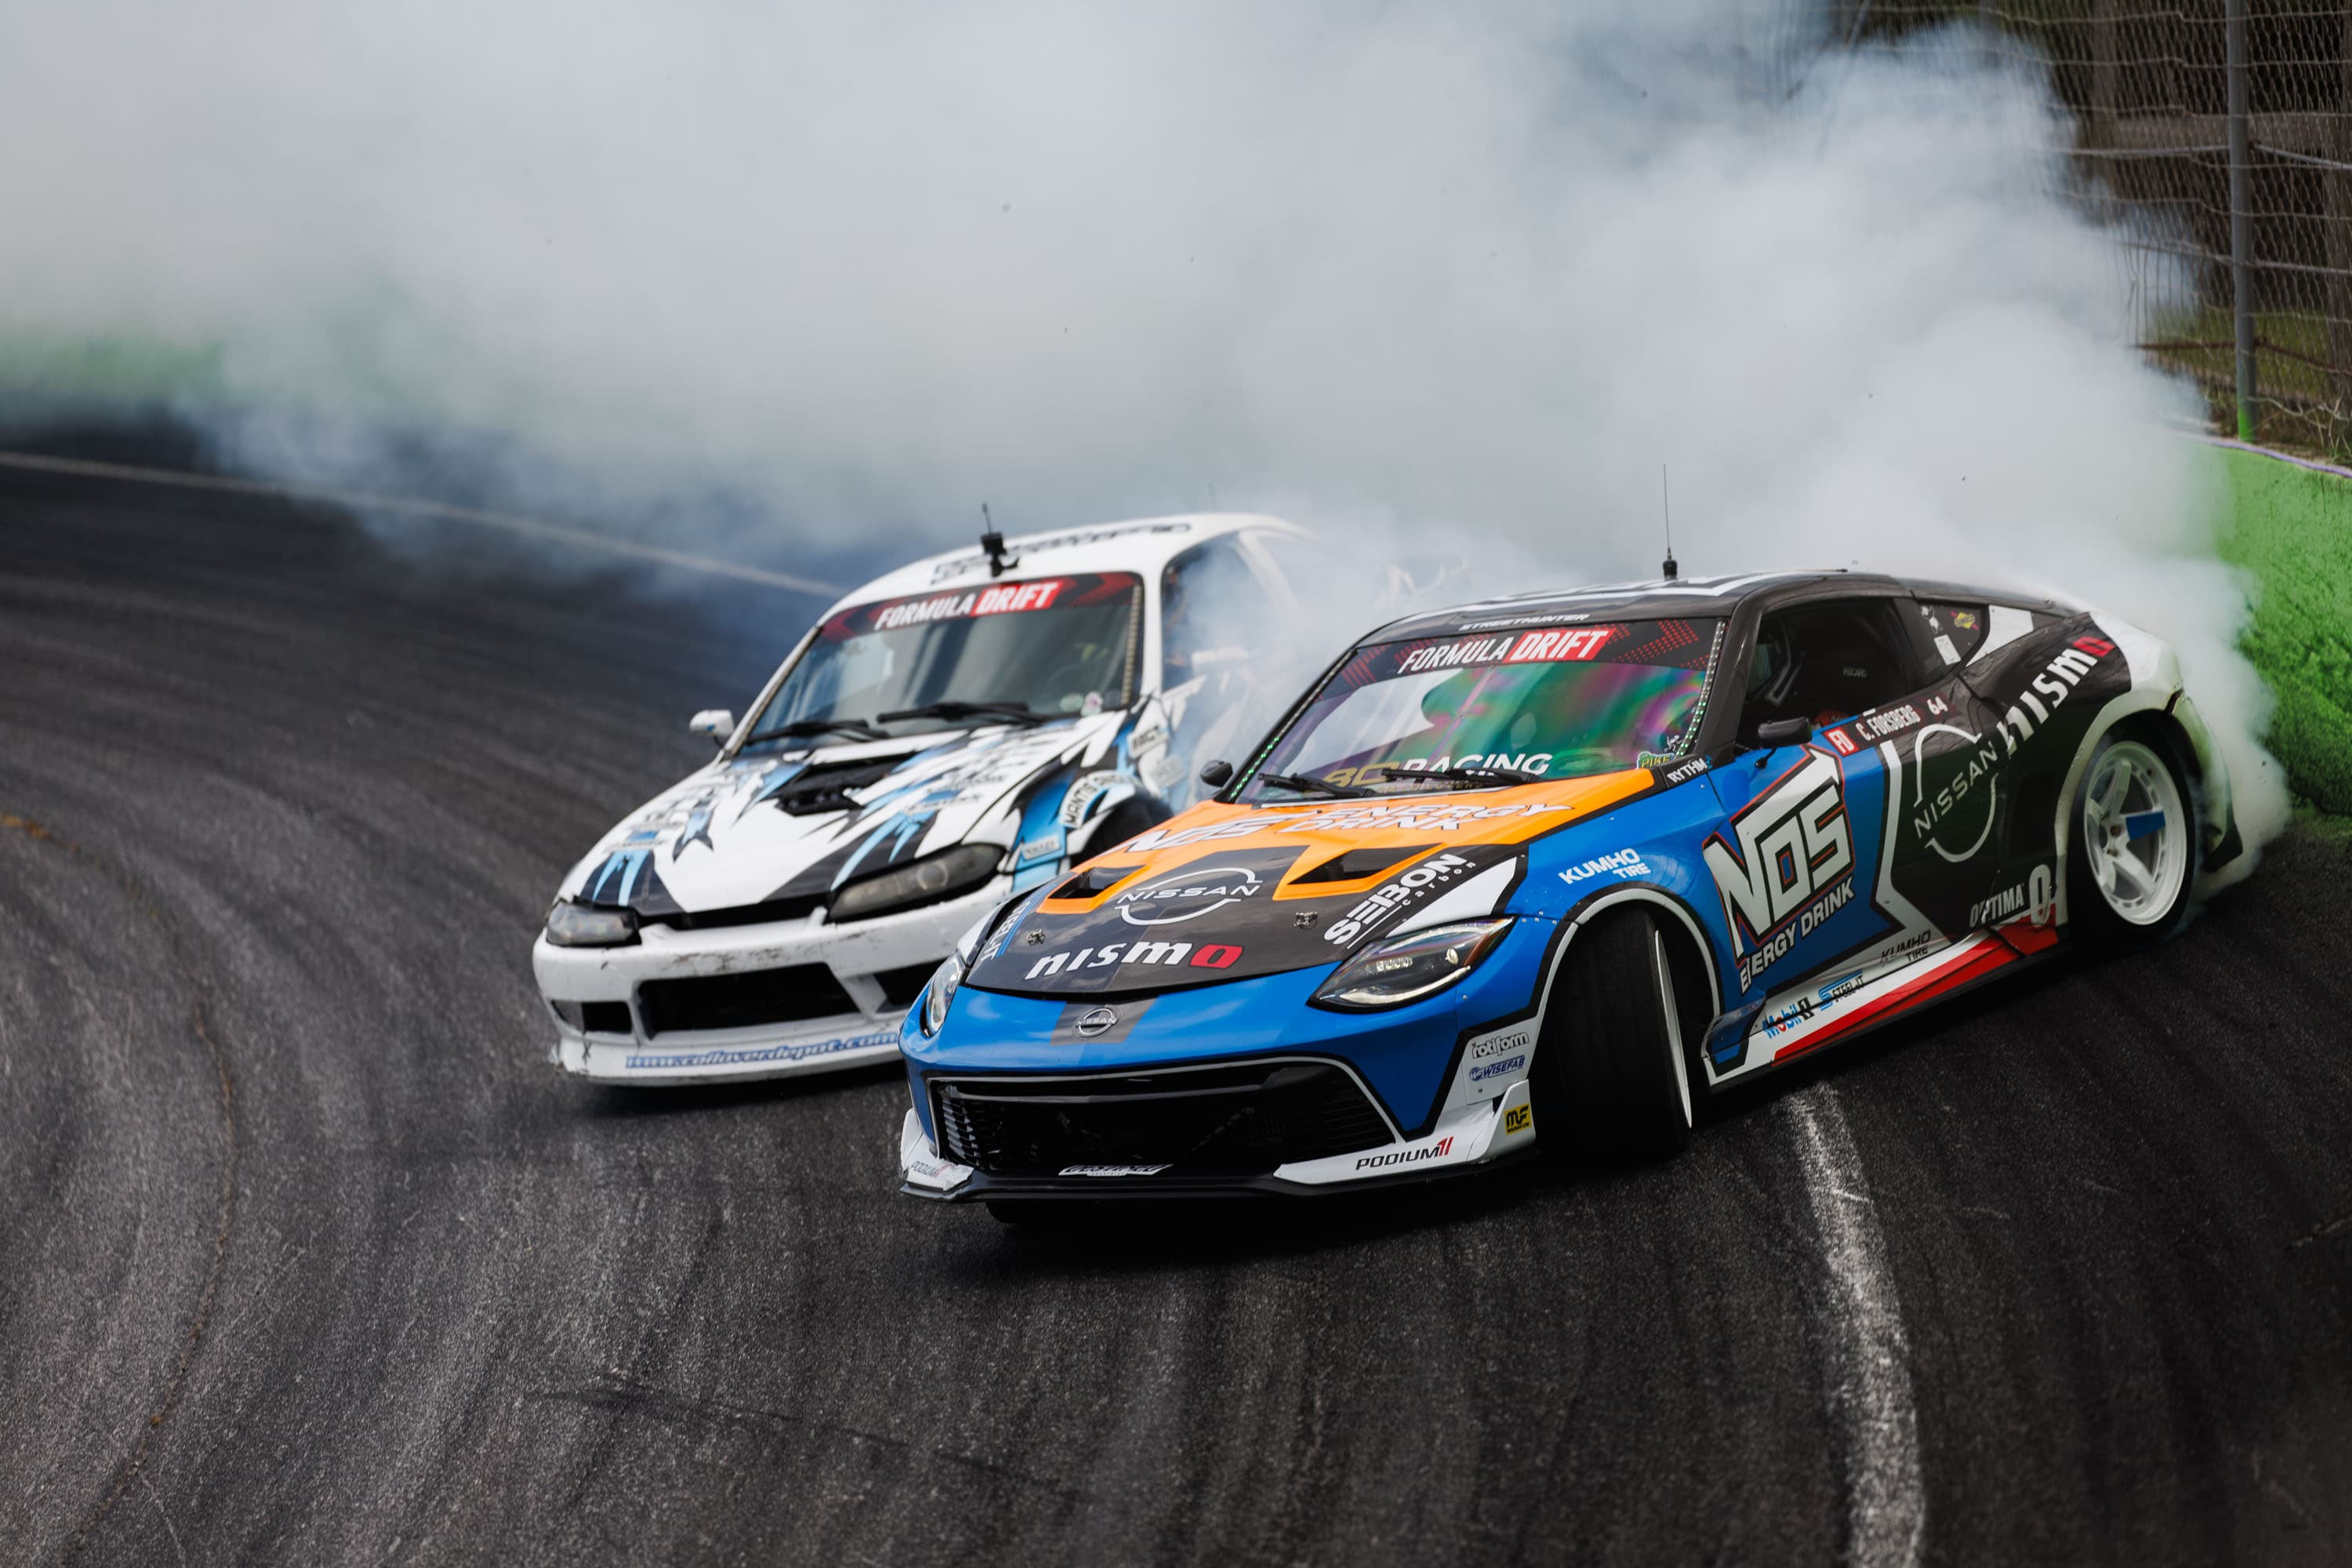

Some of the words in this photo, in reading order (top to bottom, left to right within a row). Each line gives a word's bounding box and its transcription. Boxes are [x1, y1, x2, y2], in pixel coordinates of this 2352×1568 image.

[873, 593, 978, 631] FORMULA
[975, 582, 1062, 614] DRIFT
[1457, 613, 1590, 631] STREETHUNTER
[1397, 636, 1515, 674] FORMULA
[1509, 630, 1609, 662] DRIFT
[1926, 695, 1949, 715] 64
[1996, 636, 2116, 758] nismo
[1395, 753, 1553, 785] RACING
[1666, 757, 1708, 783] RYTHM
[1914, 740, 1998, 839] NISSAN
[1275, 815, 1477, 834] DRINK
[1308, 803, 1575, 822] ENERGY
[1558, 847, 1641, 884] KUMHO
[1702, 745, 1852, 959] NOS
[1402, 862, 1476, 906] carbon
[1612, 862, 1652, 879] TIRE
[1116, 884, 1261, 904] NISSAN
[1323, 853, 1468, 946] SEIBON
[1800, 875, 1856, 938] DRINK
[1969, 883, 2025, 928] OPTIMA
[1024, 941, 1243, 980] nismo
[1880, 930, 1932, 965] KUMHO
[1905, 946, 1929, 963] TIRE
[1076, 1017, 1118, 1027] NISSAN
[1762, 1003, 1802, 1040] Mobil
[1472, 1031, 1530, 1060] rotiform
[1482, 1055, 1526, 1077] WISEFAB
